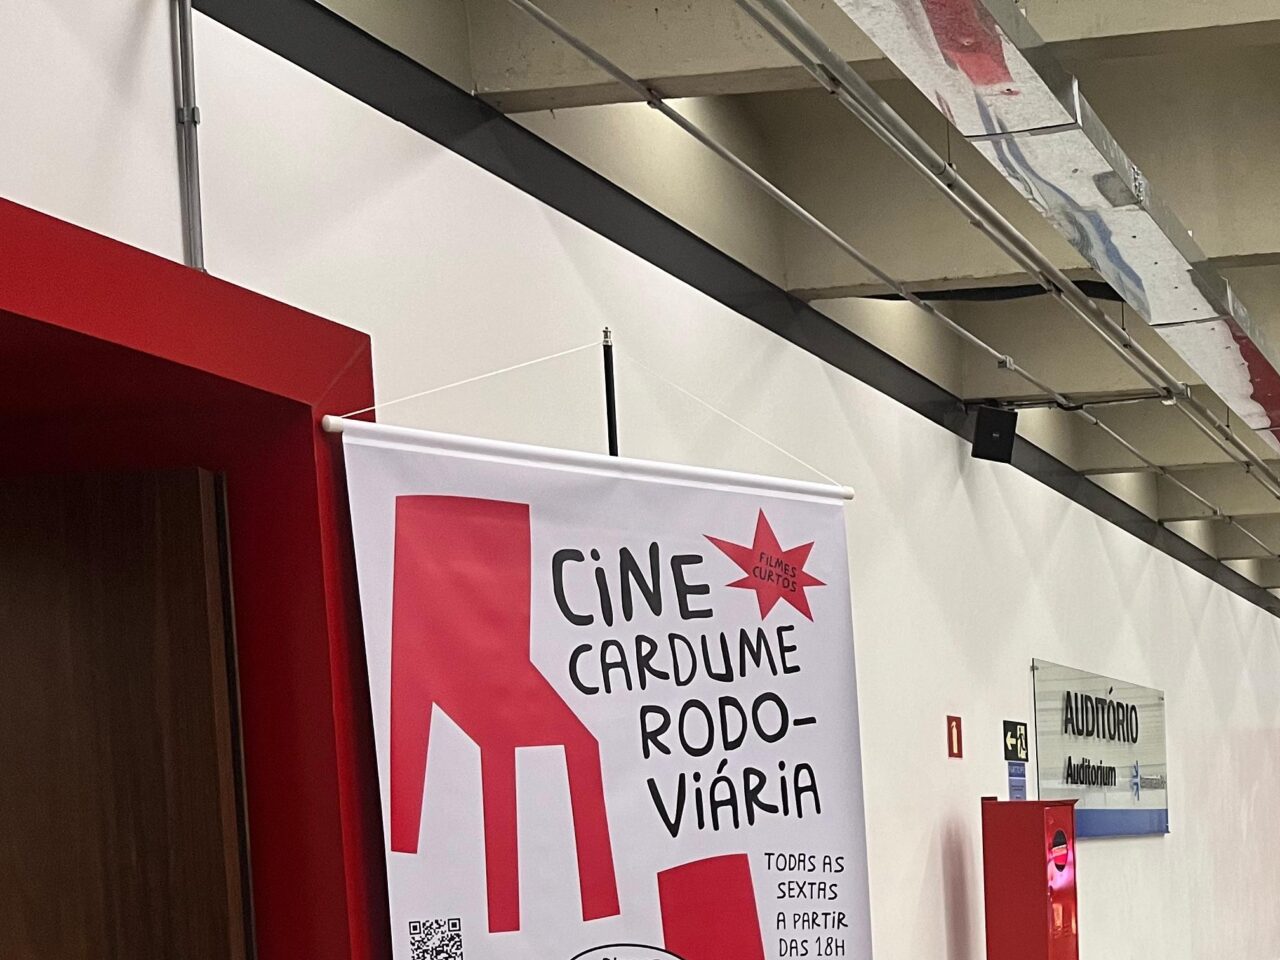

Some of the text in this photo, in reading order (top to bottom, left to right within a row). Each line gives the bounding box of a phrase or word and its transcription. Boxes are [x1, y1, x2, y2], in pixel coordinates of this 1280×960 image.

[752, 565, 798, 593] CURTOS
[568, 624, 801, 695] CARDUME
[640, 692, 817, 759] RODO-
[1064, 686, 1139, 744] AUDITÓRIO
[1065, 756, 1117, 787] Auditorium
[764, 852, 845, 873] TODAS AS
[777, 880, 838, 900] SEXTAS
[777, 911, 786, 930] A
[779, 936, 845, 957] DAS 18H
